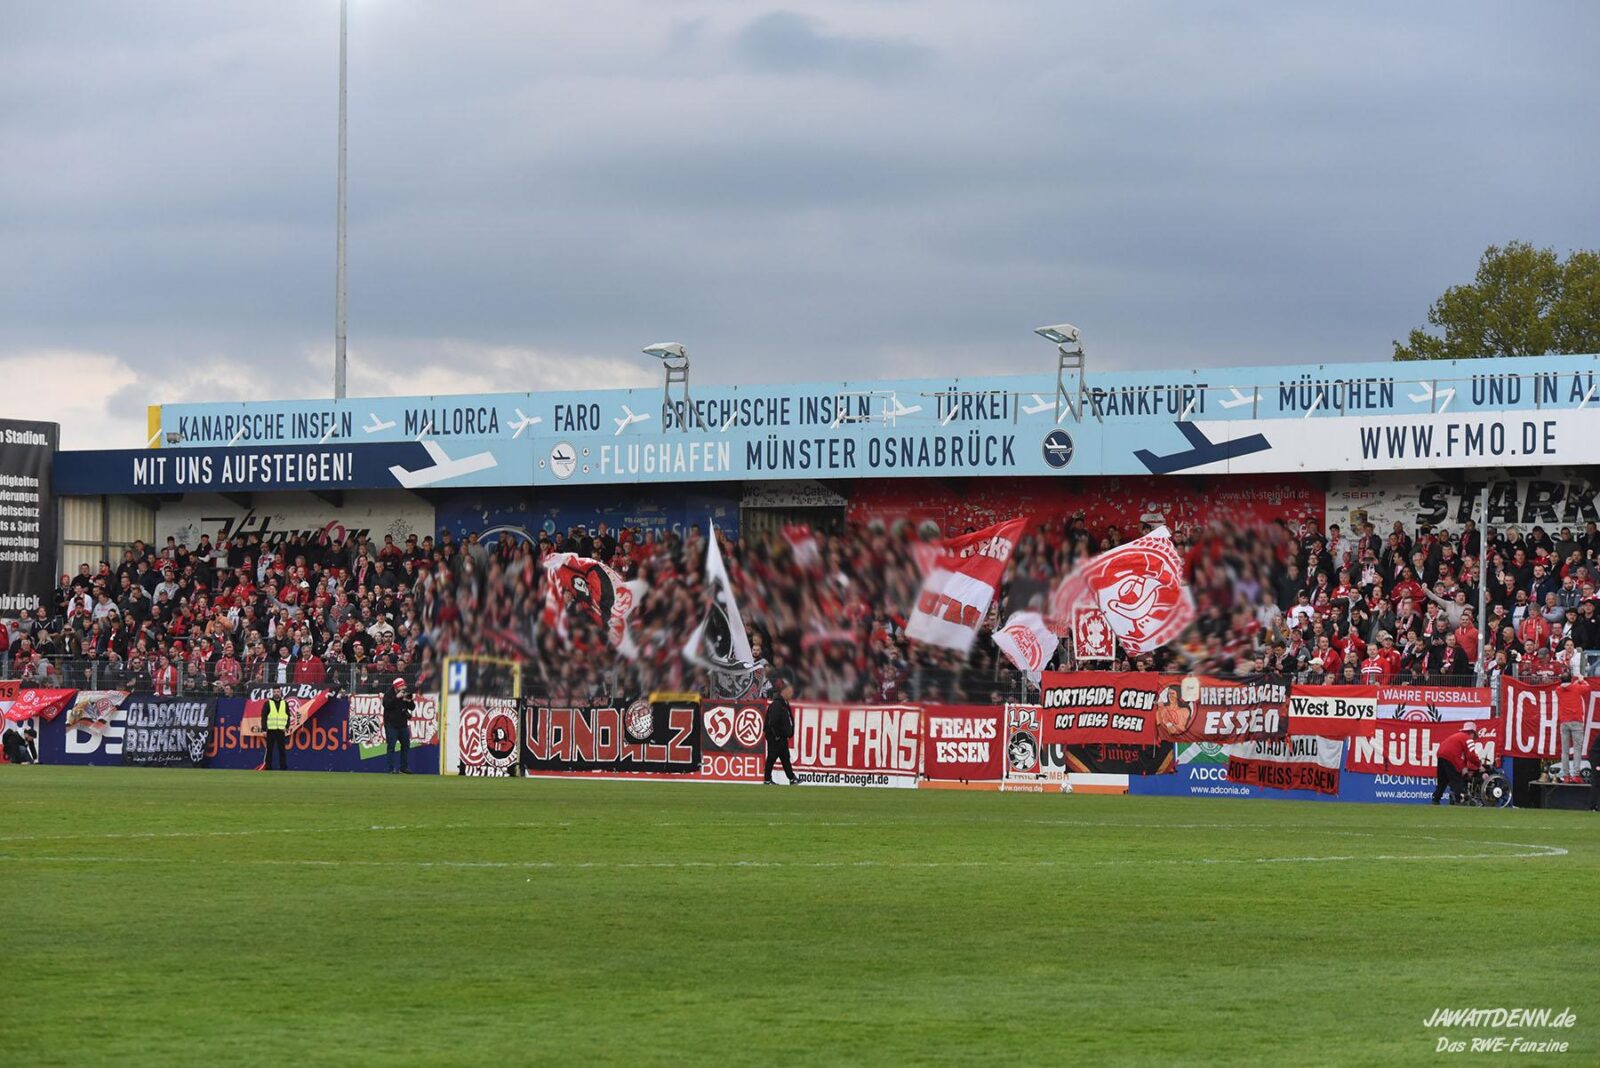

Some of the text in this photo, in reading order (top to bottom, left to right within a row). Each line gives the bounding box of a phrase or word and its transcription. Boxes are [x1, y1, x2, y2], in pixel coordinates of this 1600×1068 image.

[1081, 383, 1208, 417] FRANKFURT
[1279, 374, 1394, 411] MÜNCHEN
[1472, 373, 1521, 405] UND
[1535, 372, 1558, 404] IN
[662, 395, 870, 428] GRIECHISCHE INSELN
[935, 387, 1008, 420] TÜRKEI
[180, 411, 352, 442] KANARISCHE INSELN
[405, 407, 499, 435] MALLORCA
[554, 403, 600, 432] FARO
[5, 429, 48, 445] Stadion.
[1360, 421, 1557, 460] WWW.FMO.DE
[600, 430, 1016, 475] FLUGHAFEN MÜNSTER OSNABRÜCK
[134, 452, 353, 485] MIT UNS AUFSTEIGEN!
[1342, 491, 1377, 499] SEAT
[10, 522, 16, 531] &
[17, 520, 40, 533] Sport
[1044, 687, 1156, 711] NORTHSIDE CREW
[1200, 682, 1286, 706] HAFENSÄNGER
[1383, 688, 1421, 702] WAHRE
[1424, 690, 1481, 704] FUSSBALL
[127, 703, 209, 727] OLDSCHOOL
[1009, 709, 1040, 730] LPL
[1291, 697, 1374, 721] West Boys
[1505, 685, 1558, 756] ICH
[929, 717, 997, 739] FREAKS
[1055, 712, 1143, 732] ROT WEISS ESSEN
[1204, 708, 1280, 735] ESSEN
[127, 728, 187, 752] BREMEN
[848, 709, 920, 770] FANS
[936, 741, 989, 763] ESSEN
[1096, 743, 1139, 763] Jungs
[465, 765, 510, 777] ULTRAS
[1229, 761, 1335, 790] ROT-WEISS-ESSEN
[1190, 786, 1250, 795] www.adconia.de
